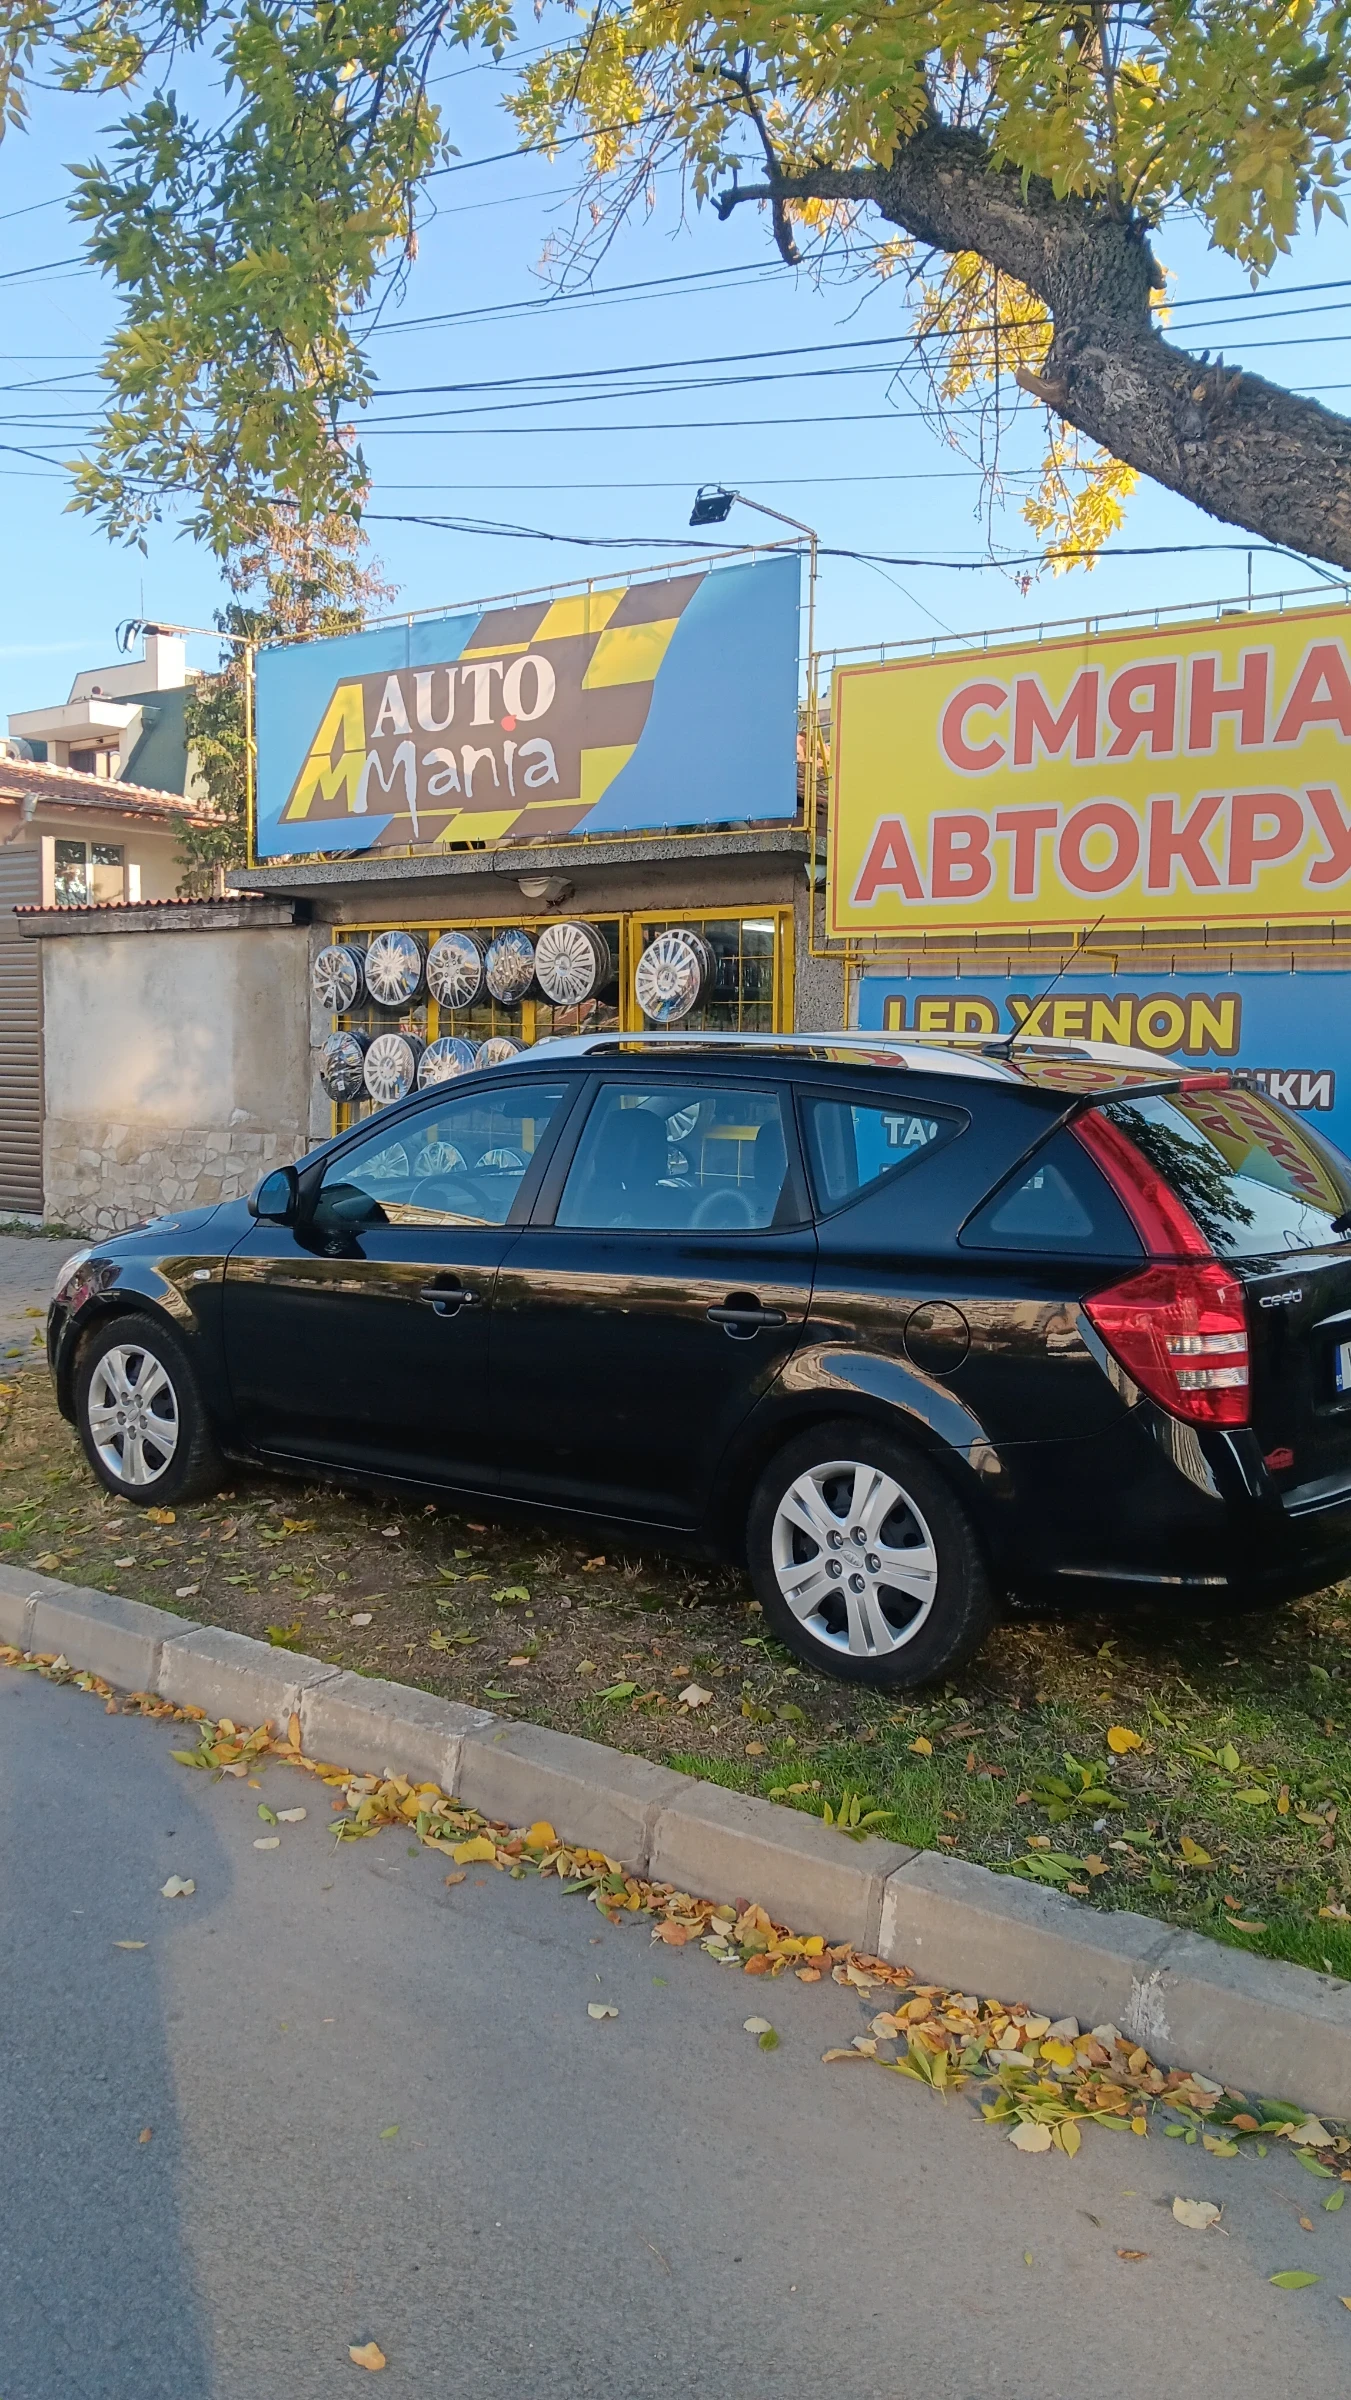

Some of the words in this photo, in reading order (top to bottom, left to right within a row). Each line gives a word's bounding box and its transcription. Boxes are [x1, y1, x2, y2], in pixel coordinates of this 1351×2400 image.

[371, 655, 556, 738] AUTO
[942, 644, 1351, 771] СМЯНА
[353, 736, 559, 839] Mania
[1012, 999, 1235, 1049] XENON
